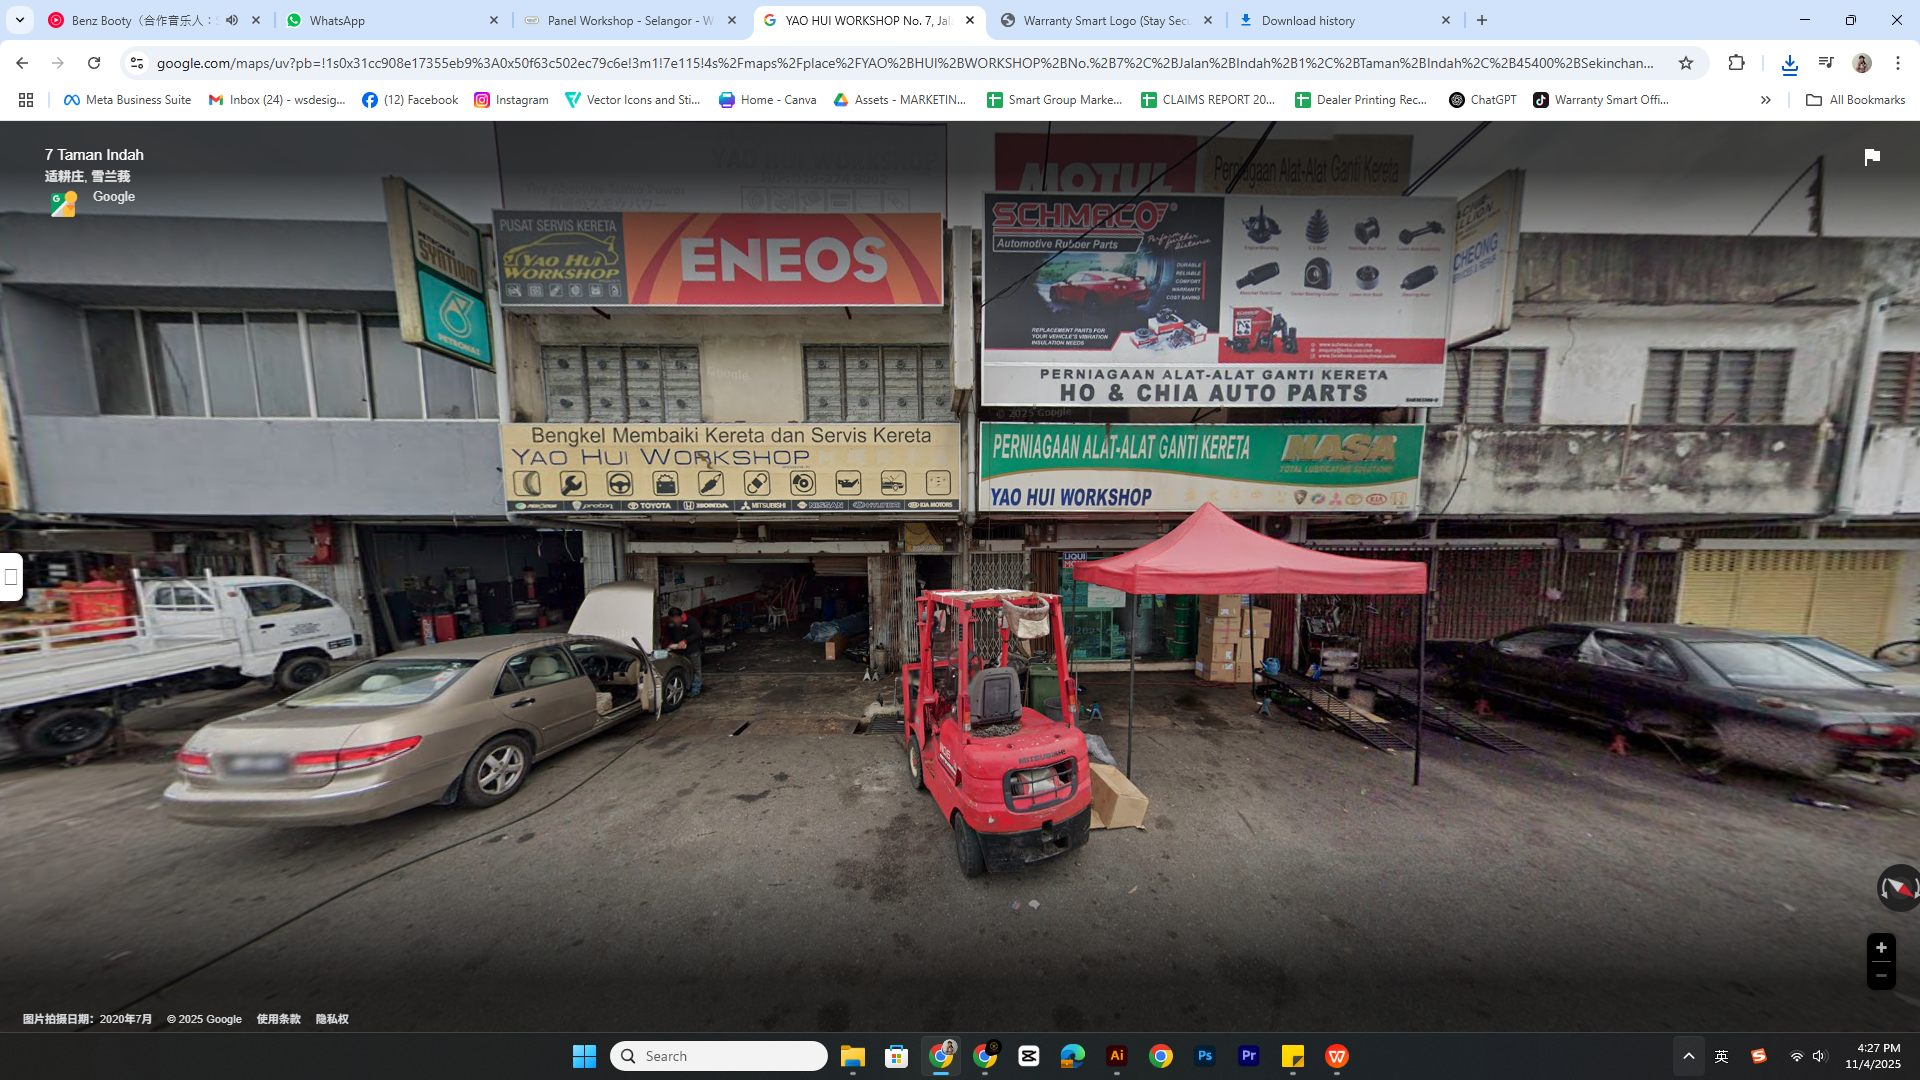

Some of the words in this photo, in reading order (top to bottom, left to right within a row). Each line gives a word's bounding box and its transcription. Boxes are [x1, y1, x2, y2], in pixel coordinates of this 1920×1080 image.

[72, 15, 98, 26] Benz
[101, 15, 132, 28] Booty
[310, 15, 365, 28] WhatsApp
[548, 15, 577, 26] Panel
[580, 15, 634, 28] Workshop
[645, 15, 692, 28] Selangor
[786, 15, 808, 26] YAO
[812, 15, 831, 26] HUI
[835, 15, 900, 26] WORKSHOP
[903, 15, 922, 26] No.
[925, 15, 934, 28] 7,
[1024, 15, 1072, 28] Warranty
[1075, 15, 1106, 26] Smart
[1110, 15, 1137, 28] Logo
[1140, 15, 1166, 28] (Stay
[1262, 15, 1315, 26] Download
[1319, 15, 1356, 28] history
[86, 94, 114, 105] Meta
[116, 94, 163, 105] Business
[164, 94, 192, 105] Suite
[230, 94, 261, 105] Inbox
[262, 94, 284, 107] (24)
[293, 94, 346, 108] wsdesig...
[383, 94, 405, 107] (12)
[407, 94, 459, 105] Facebook
[496, 94, 549, 108] Instagram
[586, 94, 622, 105] Vector
[624, 94, 653, 105] Icons
[654, 94, 676, 105] and
[677, 94, 701, 105] Sti...
[741, 94, 774, 105] Home
[783, 94, 817, 105] Canva
[854, 94, 890, 105] Assets
[899, 94, 966, 105] MARKETIN...
[1008, 94, 1041, 105] Smart
[1042, 94, 1078, 108] Group
[1080, 94, 1123, 105] Marke...
[1162, 94, 1206, 105] CLAIMS
[1207, 94, 1251, 105] REPORT
[1252, 94, 1275, 105] 20...
[1317, 94, 1353, 105] Dealer
[1354, 94, 1397, 108] Printing
[1399, 94, 1427, 105] Rec...
[1470, 94, 1518, 105] ChatGPT
[1554, 94, 1605, 108] Warranty
[1605, 94, 1639, 105] Smart
[1639, 94, 1669, 105] Offi...
[1829, 94, 1844, 105] All
[1846, 94, 1907, 105] Bookmarks
[812, 148, 939, 171] WORKSHOP
[1019, 162, 1175, 193] MOTUL
[1214, 154, 1277, 188] Perniagaan
[1280, 155, 1328, 184] Alat-Alat
[1331, 154, 1362, 183] Ganti
[1363, 155, 1399, 184] Kereta
[992, 200, 1163, 232] SCHMACO
[500, 219, 533, 232] PUSAT
[536, 219, 574, 232] SERVIS
[577, 219, 618, 233] KERETA
[996, 238, 1053, 250] Automotive
[1054, 238, 1092, 250] Rubber
[1092, 238, 1119, 250] Parts
[1453, 230, 1499, 272] CHEONG
[522, 253, 560, 267] YAO
[564, 253, 603, 268] HUI
[679, 236, 889, 284] ENEOS
[503, 266, 620, 280] WORKSHOP
[1040, 369, 1154, 380] PERNIAGAAN
[1162, 369, 1255, 380] ALAT-ALAT
[1262, 369, 1314, 381] GANTI
[1321, 369, 1388, 380] KERETA
[1060, 383, 1095, 402] HO
[1108, 383, 1124, 402] &
[1137, 383, 1198, 402] CHIA
[1208, 384, 1276, 402] AUTO
[1287, 384, 1367, 402] PARTS
[532, 427, 605, 447] Bengkel
[613, 427, 698, 443] Membaiki
[706, 427, 765, 443] Kereta
[771, 427, 805, 443] dan
[811, 427, 867, 443] Servis
[873, 427, 931, 443] Kereta
[993, 434, 1080, 459] PERNIAGAAN
[1082, 434, 1156, 460] ALAT-ALAT
[1159, 434, 1199, 460] GANTI
[1201, 434, 1250, 460] KERETA
[511, 448, 568, 466] YAO
[581, 448, 628, 466] HUI
[639, 448, 810, 467] WORKSHOP
[1280, 465, 1302, 473] TOTAL
[990, 487, 1022, 506] YAO
[1026, 487, 1056, 506] HUI
[1061, 488, 1152, 506] WORKSHOP
[640, 502, 672, 510] TOYOTA
[809, 501, 844, 509] NISSAN
[1064, 552, 1087, 561] LIQUI
[1018, 749, 1066, 766] MITSUBISHI
[1857, 1043, 1881, 1053] 4:27
[1883, 1043, 1901, 1053] PM
[645, 1050, 687, 1062] Search
[1110, 1049, 1124, 1061] Ai
[1198, 1049, 1213, 1062] Ps
[1242, 1049, 1257, 1061] Pr
[1714, 1049, 1729, 1064] 英
[1845, 1059, 1902, 1071] 11/4/2025
